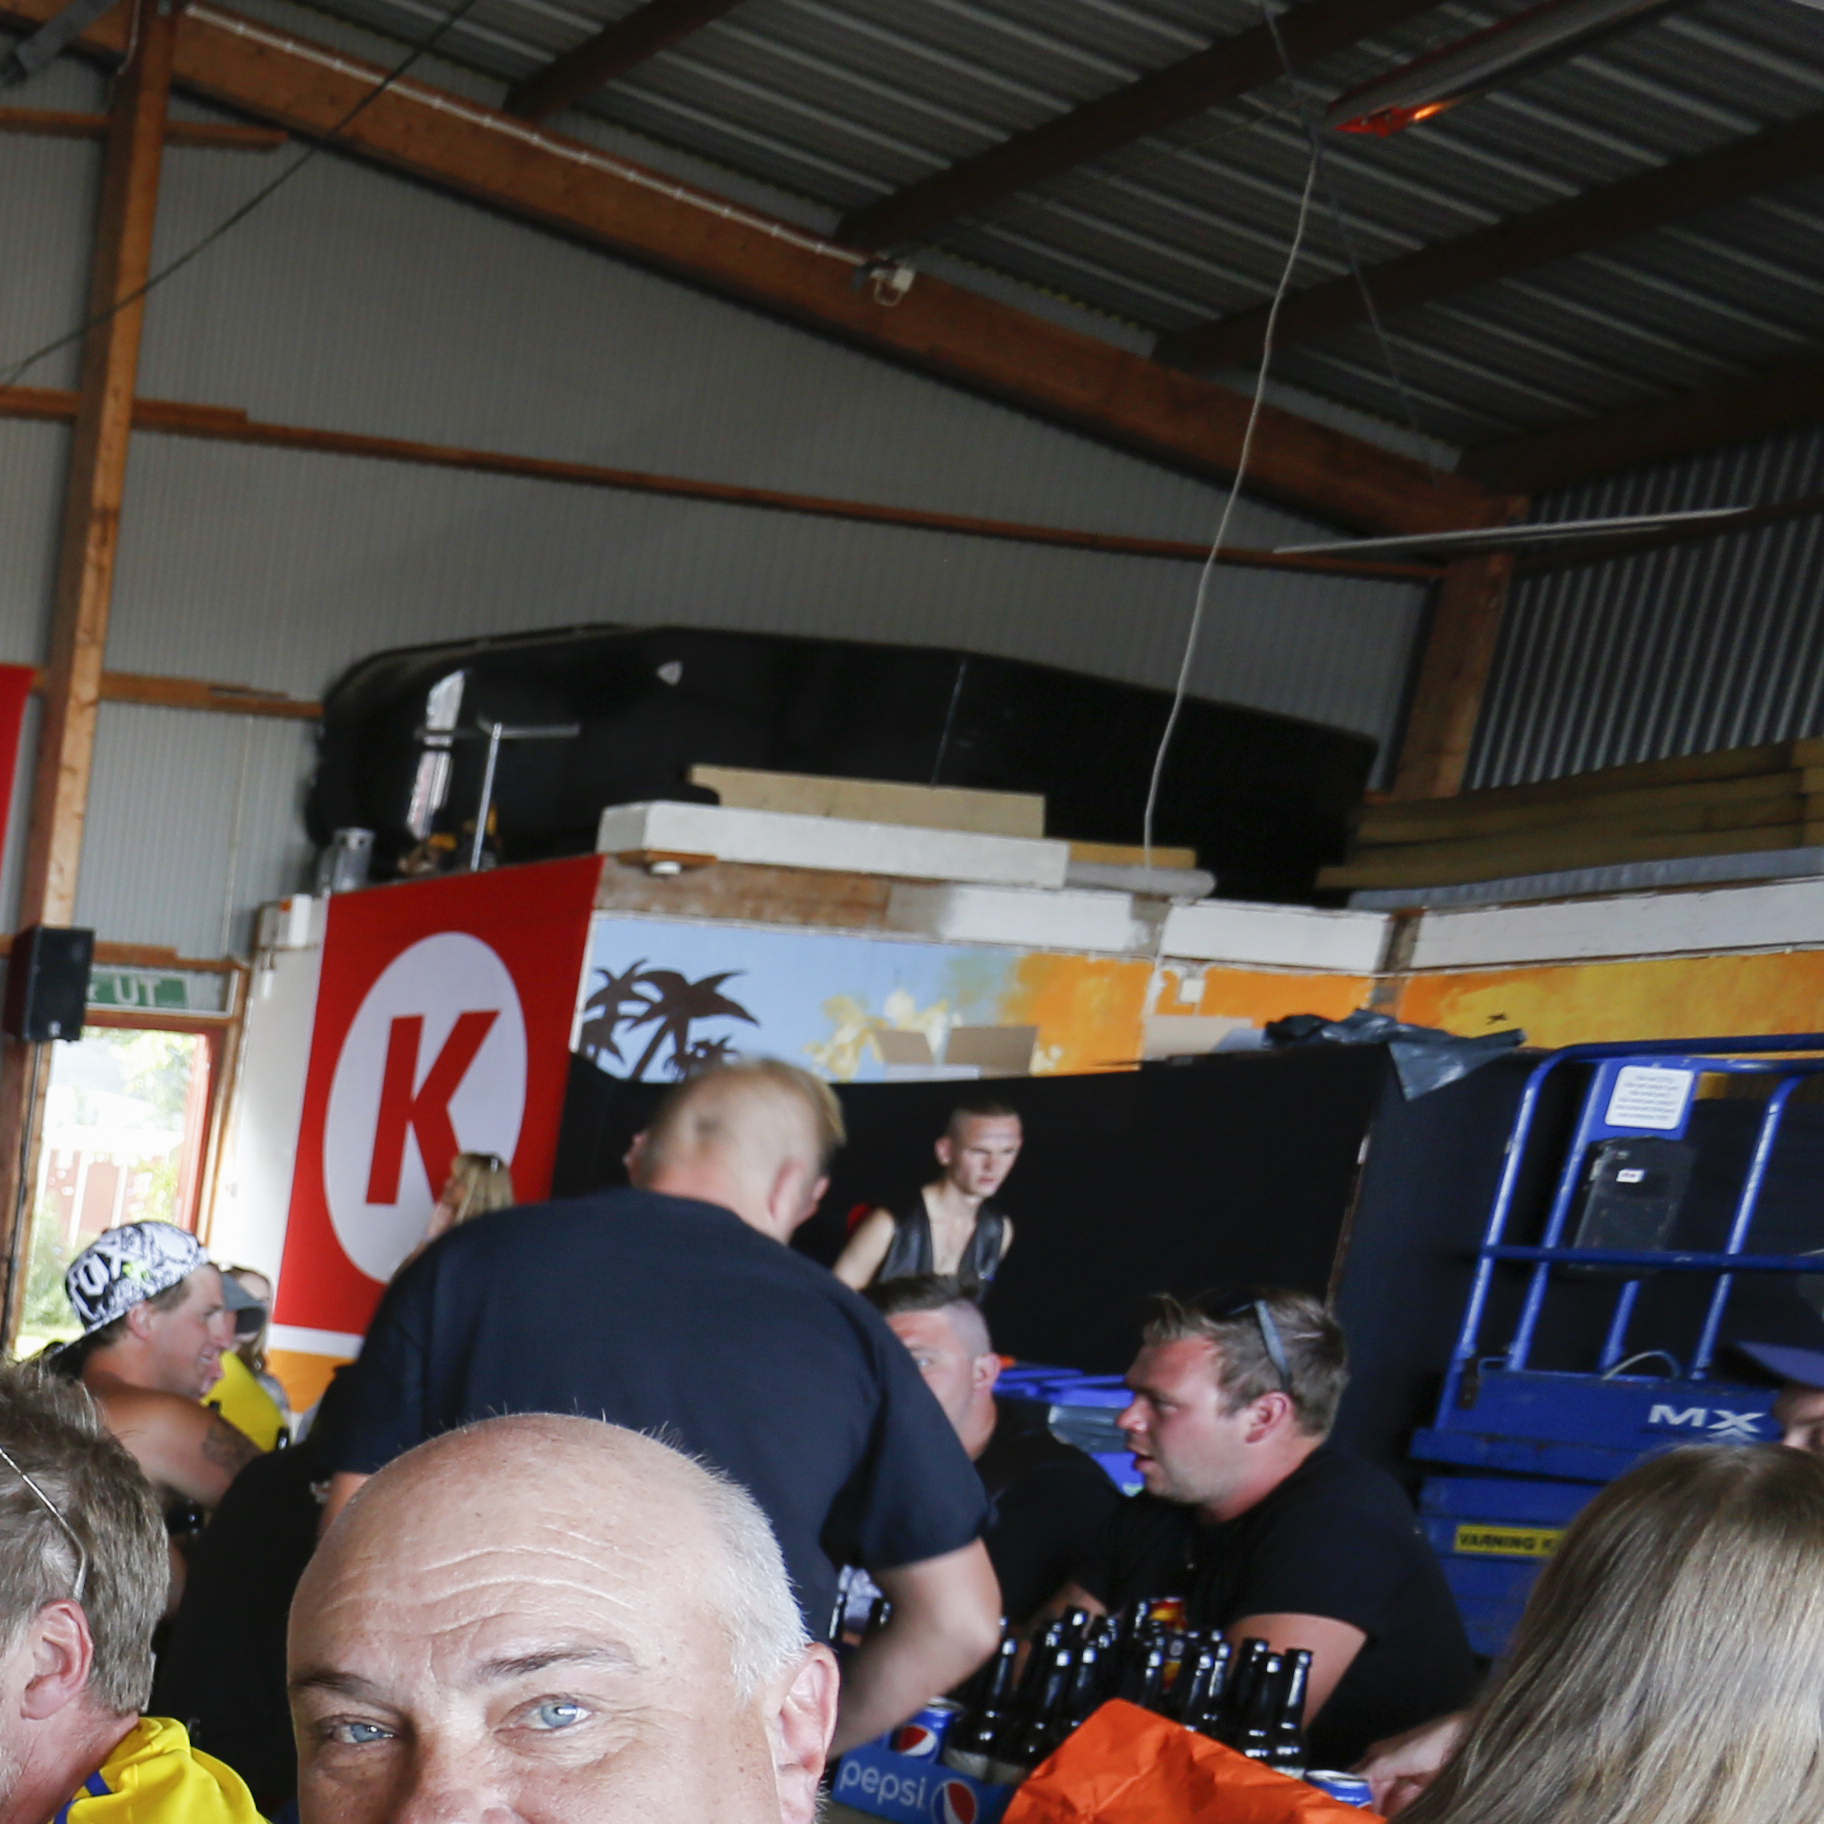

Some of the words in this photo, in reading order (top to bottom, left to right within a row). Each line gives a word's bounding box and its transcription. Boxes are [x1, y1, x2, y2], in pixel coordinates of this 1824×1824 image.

[366, 1009, 500, 1205] K
[1648, 1404, 1765, 1434] MX
[839, 1757, 928, 1813] pepsi
